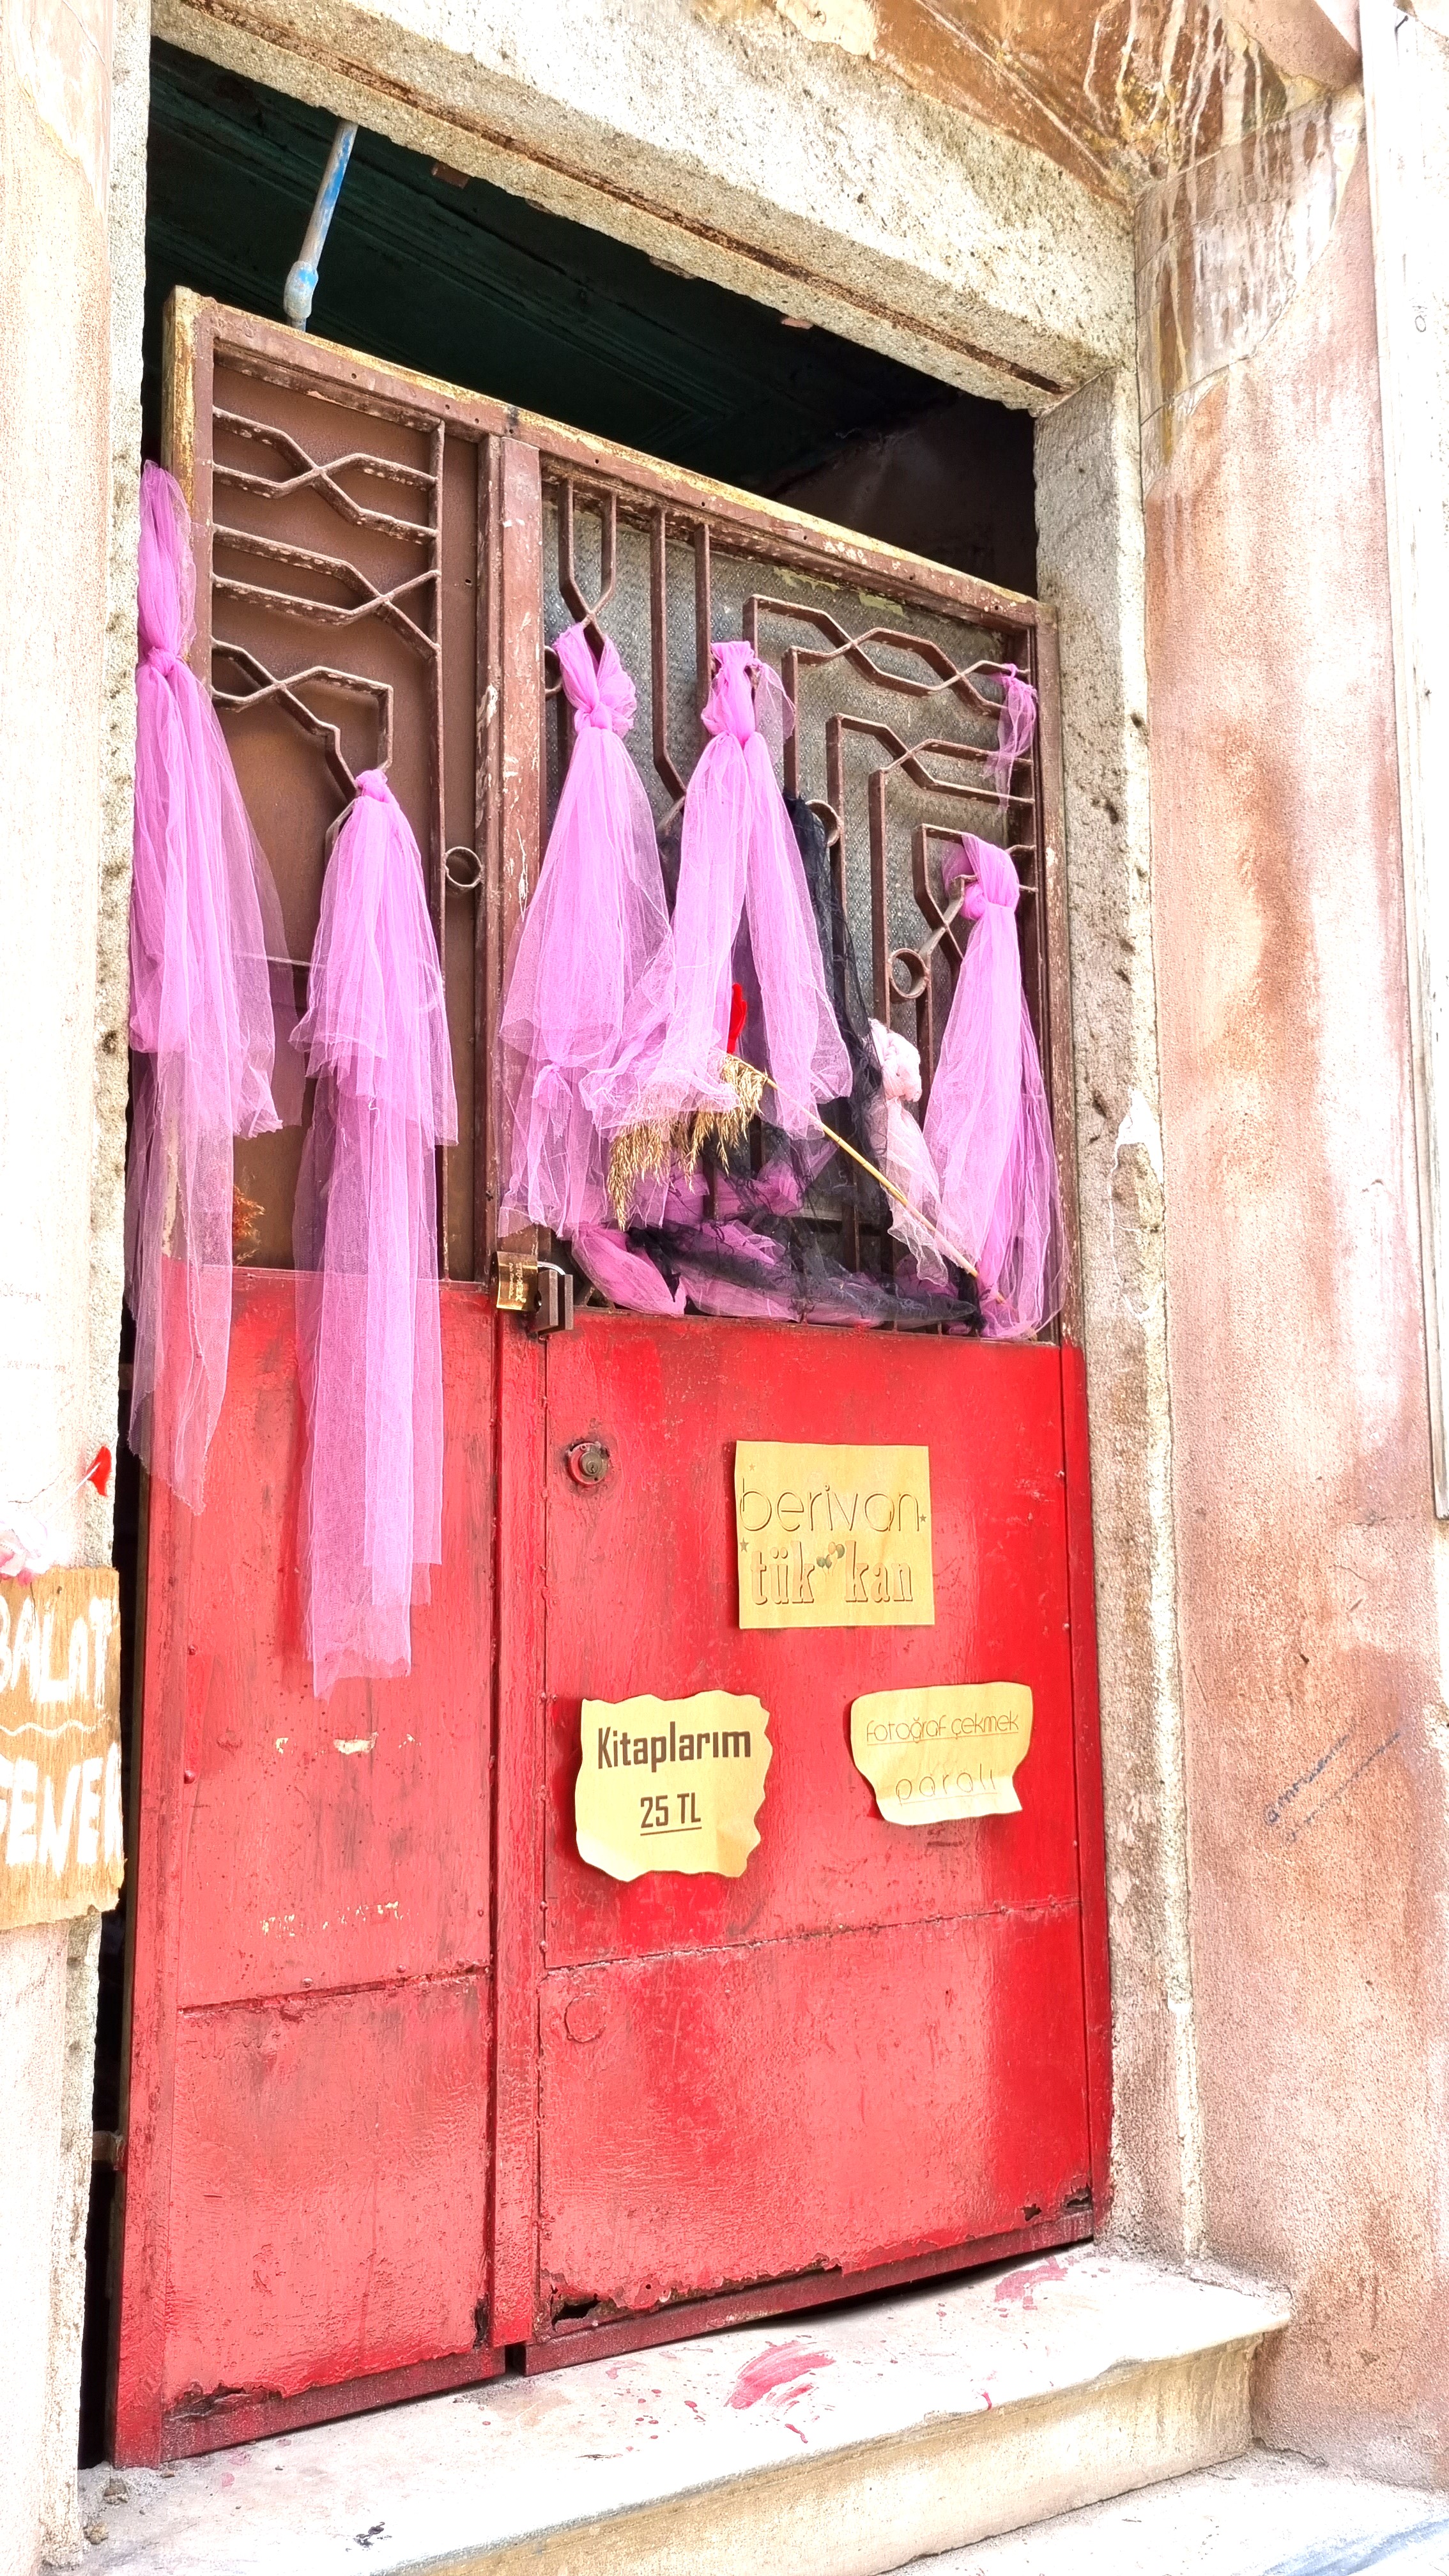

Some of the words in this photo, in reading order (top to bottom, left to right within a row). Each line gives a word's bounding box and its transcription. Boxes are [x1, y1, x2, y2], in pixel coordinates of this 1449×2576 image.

[750, 1540, 815, 1605] tük
[845, 1540, 914, 1602] kan
[597, 1721, 751, 1773] Kitaplarım
[866, 1714, 947, 1744] fotoğraf
[951, 1710, 1019, 1740] çekmek
[640, 1794, 669, 1828] 25
[677, 1791, 702, 1824] TL
